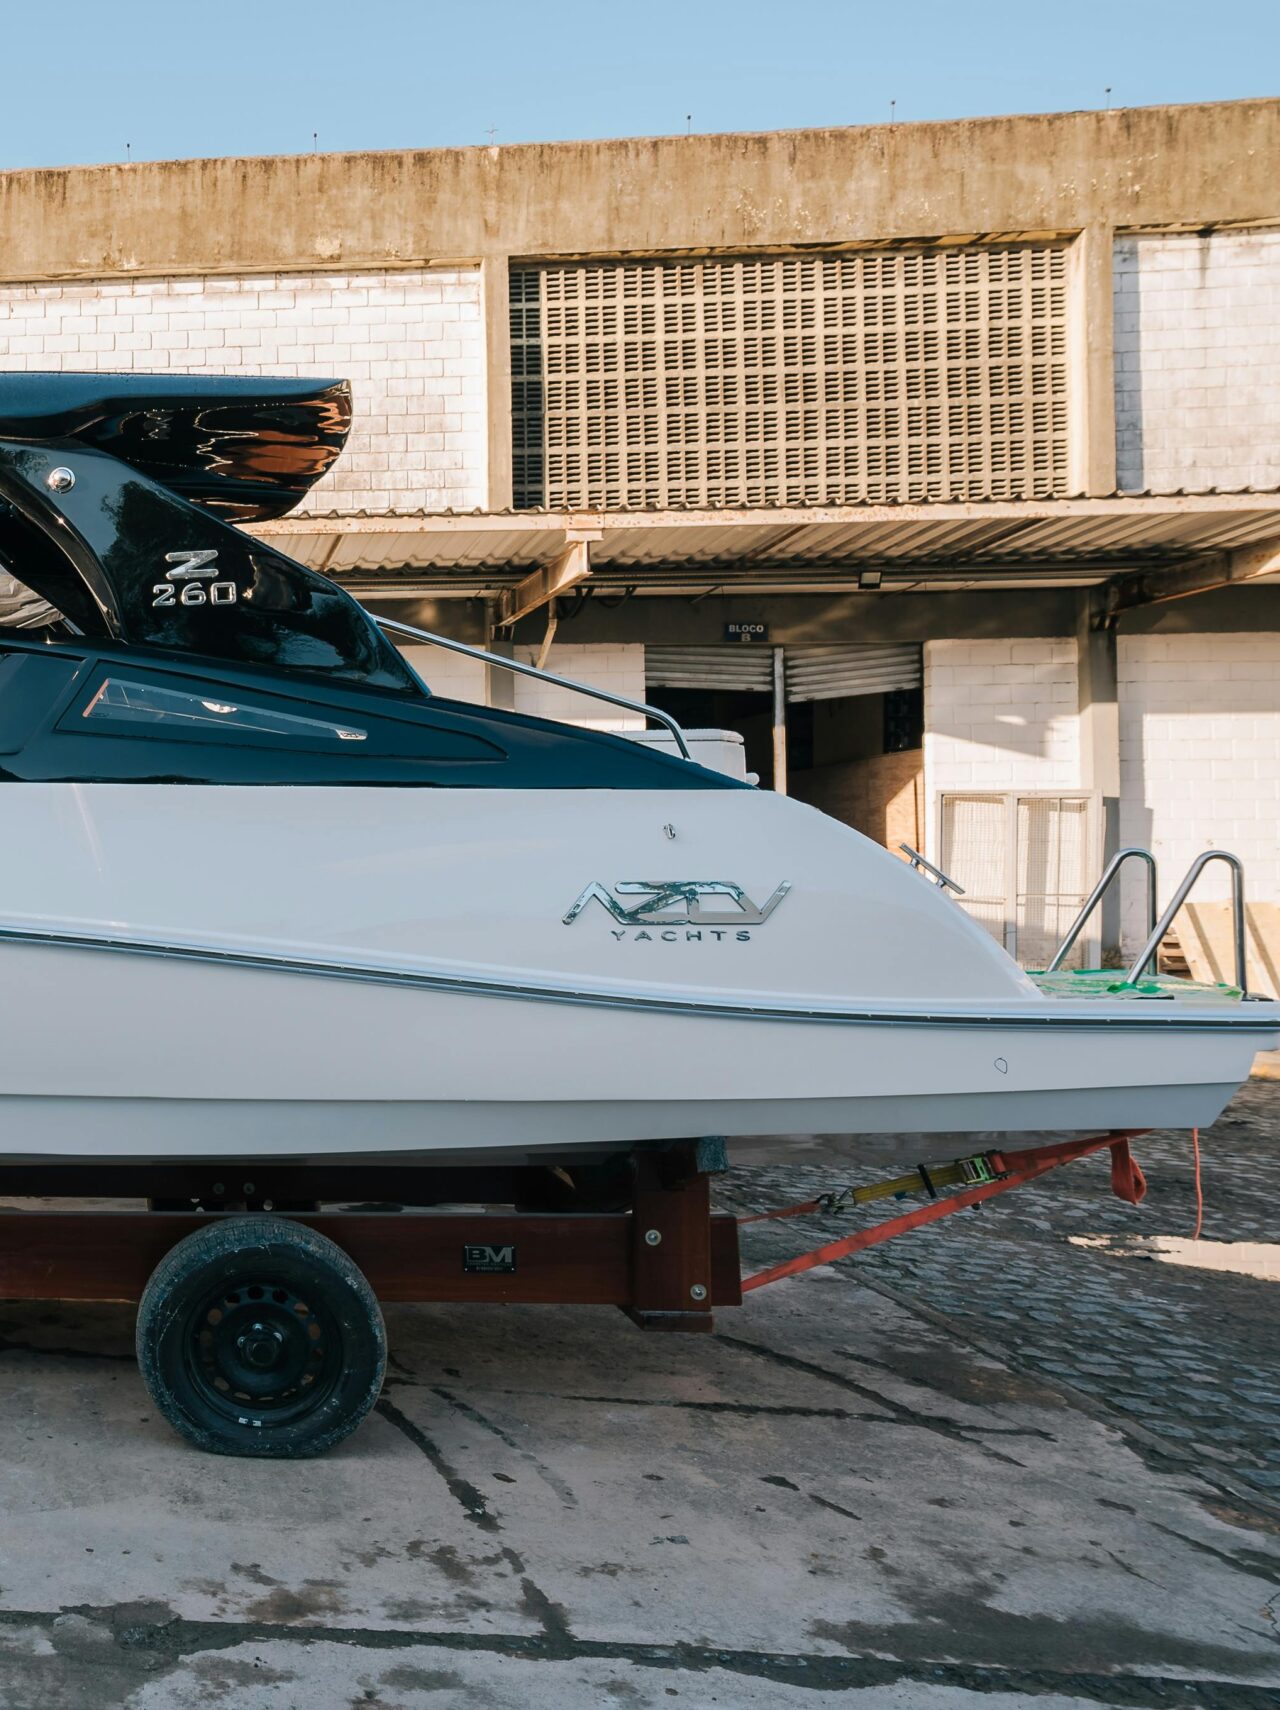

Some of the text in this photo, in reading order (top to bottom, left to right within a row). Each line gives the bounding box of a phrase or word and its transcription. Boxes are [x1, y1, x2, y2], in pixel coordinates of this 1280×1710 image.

[165, 549, 219, 580] Z
[152, 582, 237, 607] 260
[728, 624, 764, 633] BLOCO
[610, 930, 752, 942] YACHTS
